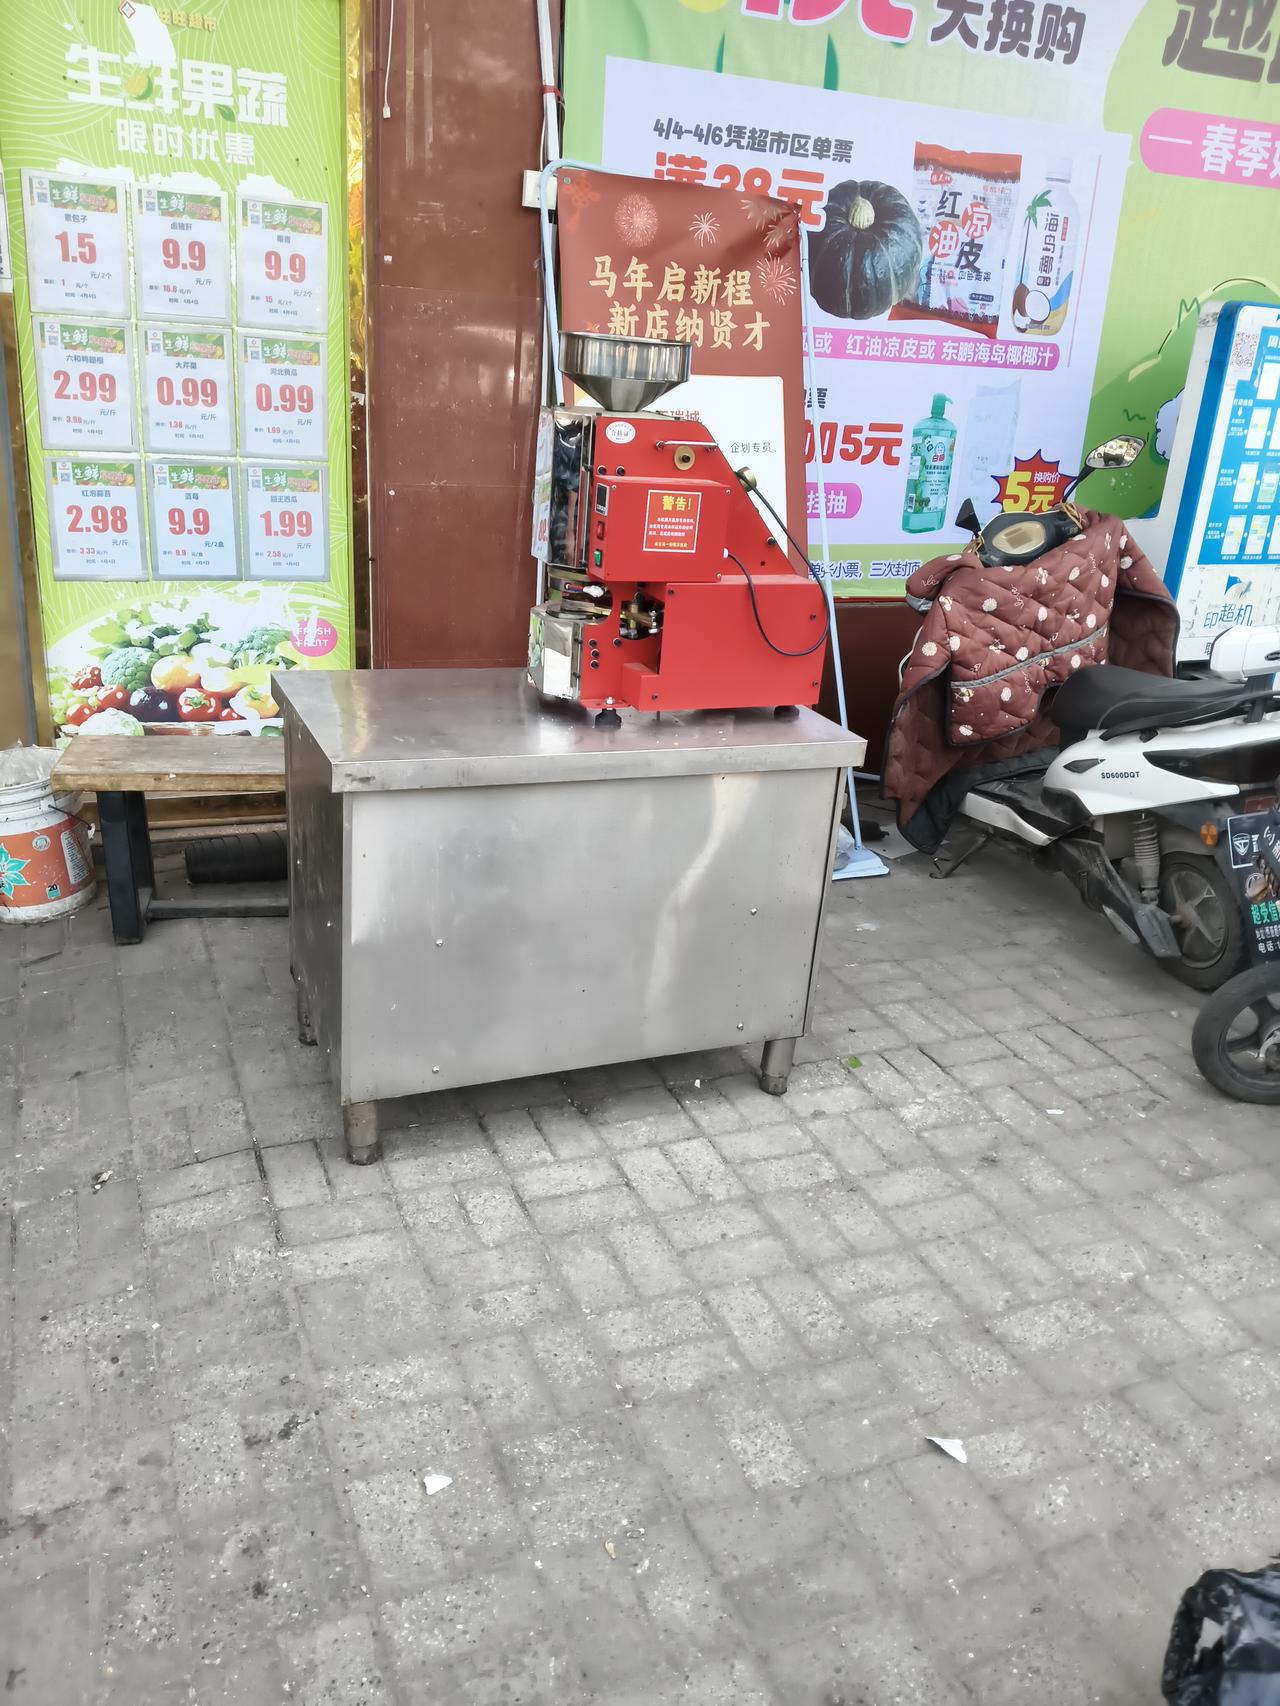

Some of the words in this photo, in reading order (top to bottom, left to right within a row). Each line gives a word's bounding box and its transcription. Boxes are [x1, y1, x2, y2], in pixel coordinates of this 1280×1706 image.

[1161, 0, 1280, 84] 趣
[55, 231, 97, 264] 1.5
[162, 238, 206, 272] 9.9
[264, 250, 306, 283] 9.9
[589, 255, 754, 307] 马年启新程
[608, 300, 771, 351] 新店纳贤才
[846, 334, 936, 360] 红油凉皮或
[941, 339, 1054, 367] 东鹏海岛椰椰汁
[53, 370, 117, 403] 2.99
[156, 376, 218, 408] 0.99
[255, 383, 314, 413] 0.99
[1002, 471, 1056, 512] 5元
[1034, 471, 1061, 484] 换购价
[66, 504, 128, 534] 2.98
[168, 507, 210, 536] 9.9
[260, 510, 313, 537] 1.99
[297, 627, 331, 635] FRSH
[1100, 771, 1140, 779] SD600DQT
